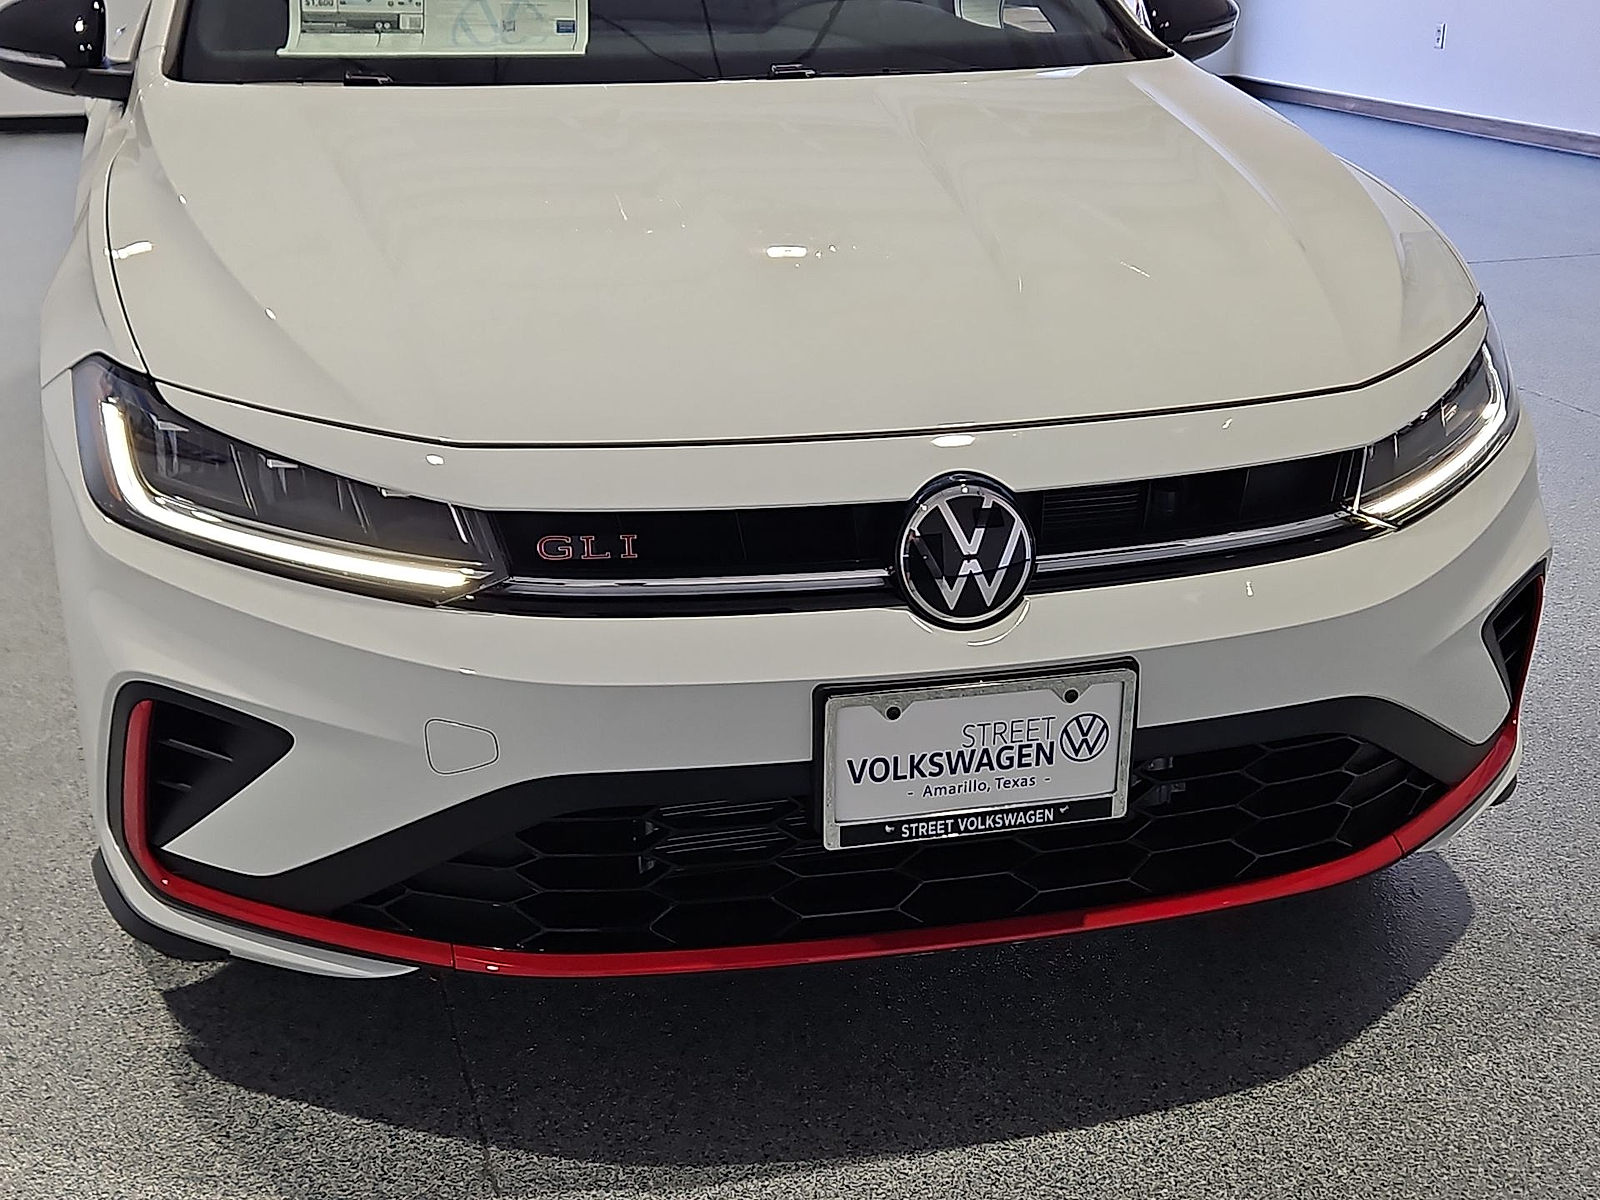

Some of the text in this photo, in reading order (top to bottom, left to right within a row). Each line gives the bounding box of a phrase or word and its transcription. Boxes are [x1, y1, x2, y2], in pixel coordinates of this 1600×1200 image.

[536, 534, 638, 561] GLI
[902, 485, 1031, 622] VW
[961, 716, 1056, 749] STREET
[1060, 713, 1109, 762] VW
[847, 741, 1055, 784] VOLKSWAGEN
[922, 779, 991, 798] Amarillo,
[995, 776, 1036, 790] Texas
[901, 808, 1054, 838] STREET VOLKSWAGEN
